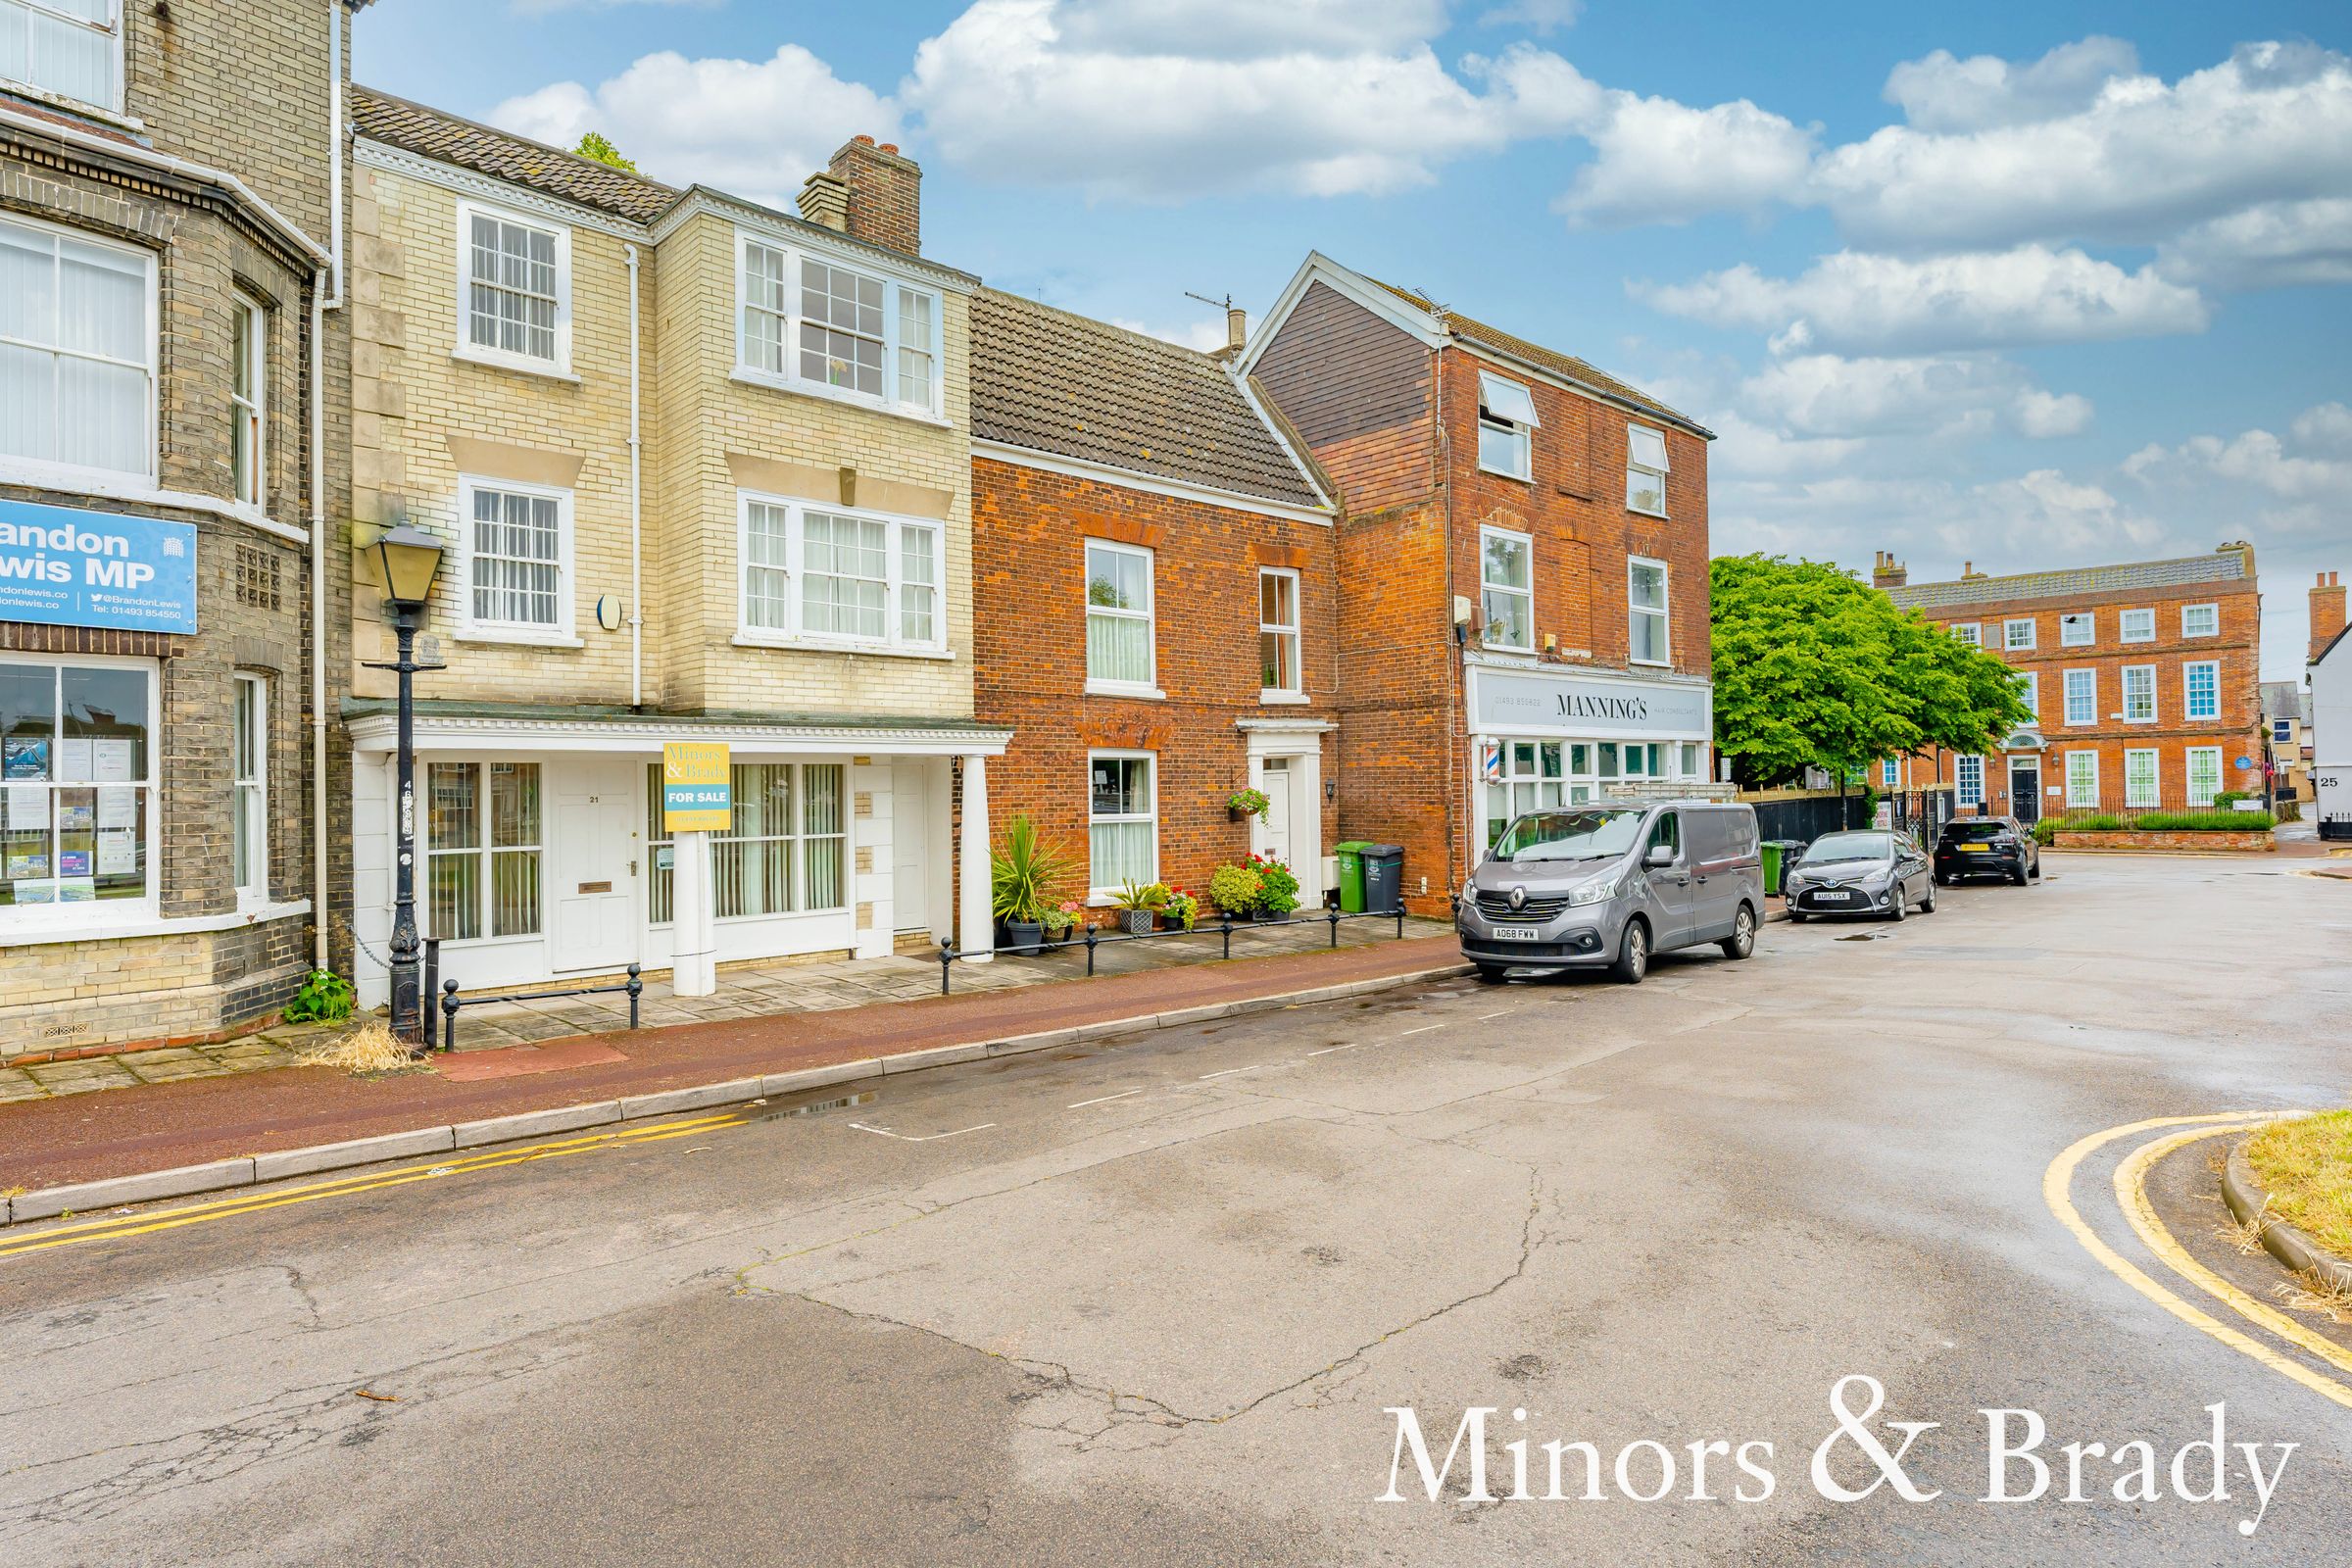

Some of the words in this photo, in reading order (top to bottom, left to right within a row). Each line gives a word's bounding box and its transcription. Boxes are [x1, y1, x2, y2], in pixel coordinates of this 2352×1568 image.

[85, 558, 155, 589] MP
[0, 596, 59, 610] onlewis.co
[103, 595, 181, 609] @BrandonLewis
[93, 605, 108, 613] Tel:
[112, 606, 142, 616] 01493
[145, 610, 181, 619] 854550
[1557, 694, 1646, 720] MANNING'S
[669, 746, 720, 760] Minors
[666, 760, 682, 778] &
[686, 763, 726, 781] Brady
[2321, 777, 2338, 787] 25
[668, 793, 694, 803] FOR
[697, 792, 726, 802] SALE
[1518, 930, 1535, 939] FWW
